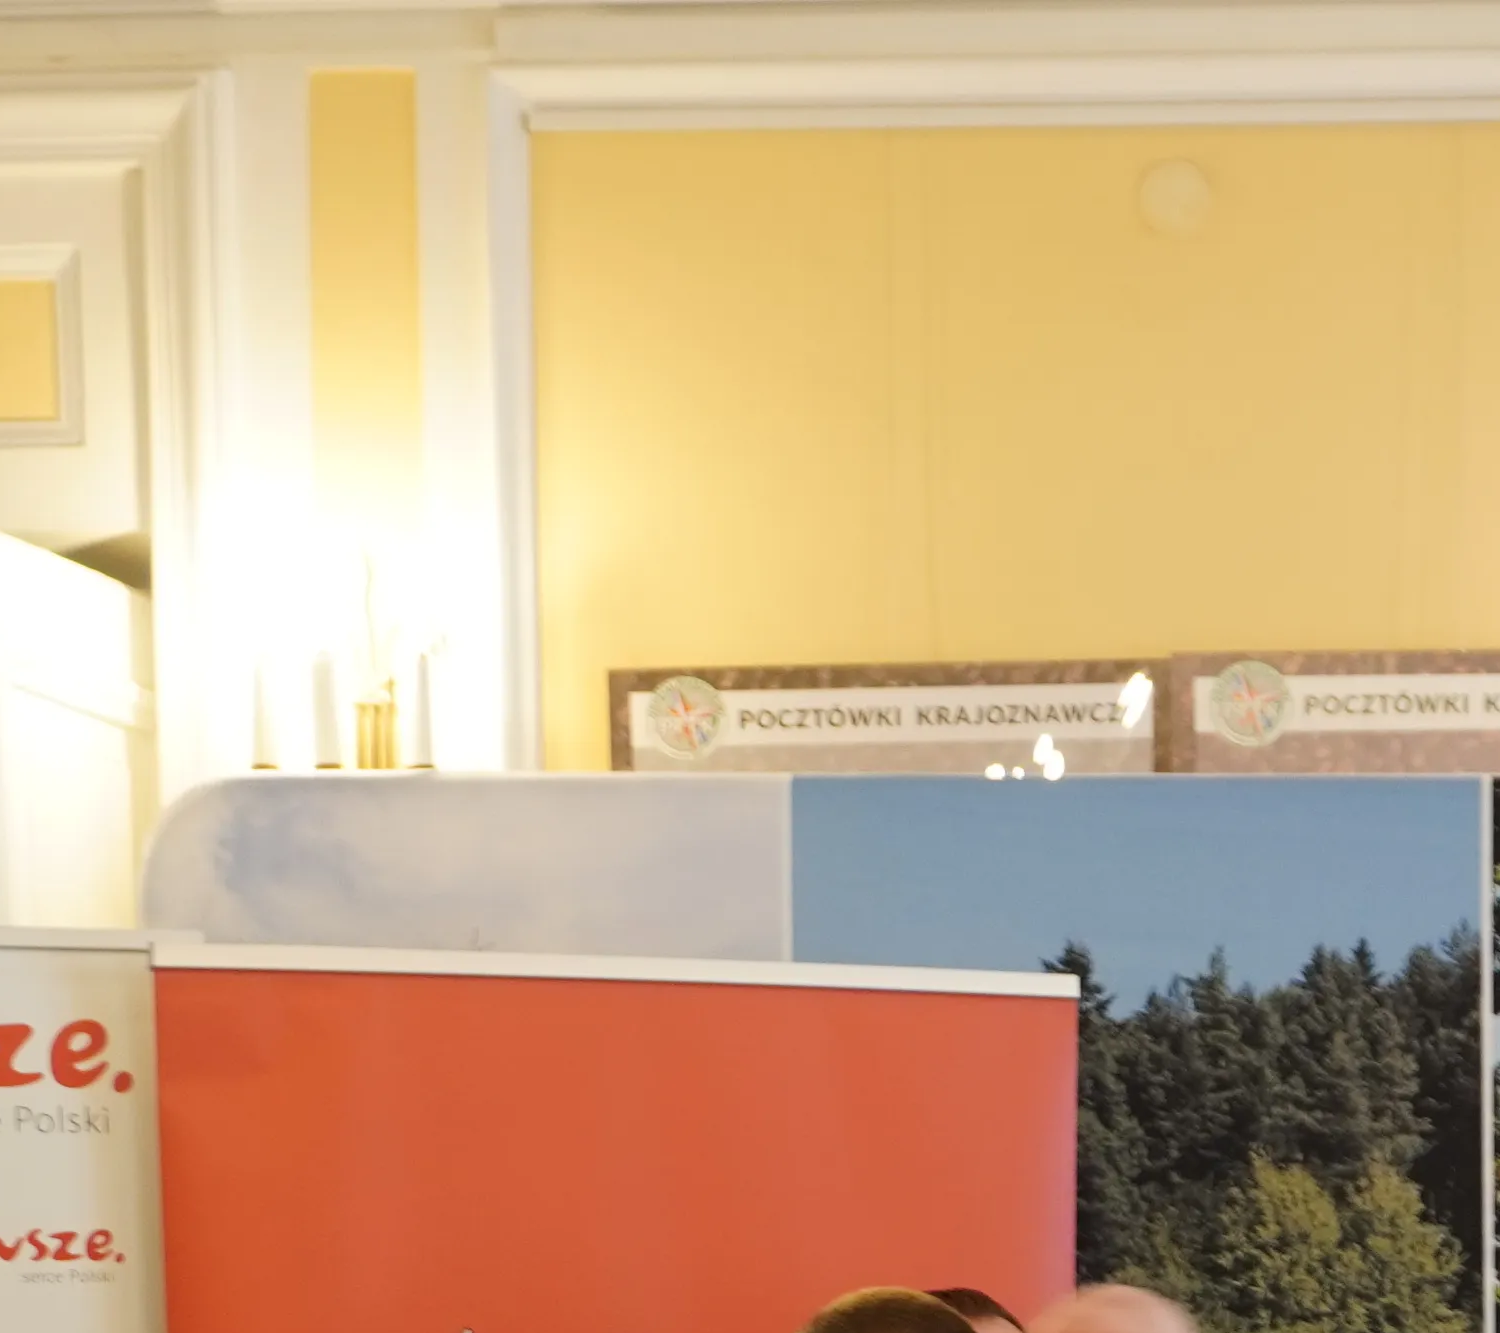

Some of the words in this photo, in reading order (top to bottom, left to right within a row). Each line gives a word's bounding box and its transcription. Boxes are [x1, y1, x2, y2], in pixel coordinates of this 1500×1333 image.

[739, 702, 902, 730] POCZTÓWKI
[915, 701, 1125, 727] KRAJOZNAWCZ
[1304, 690, 1469, 716] POCZTÓWKI
[13, 1104, 112, 1135] Polski
